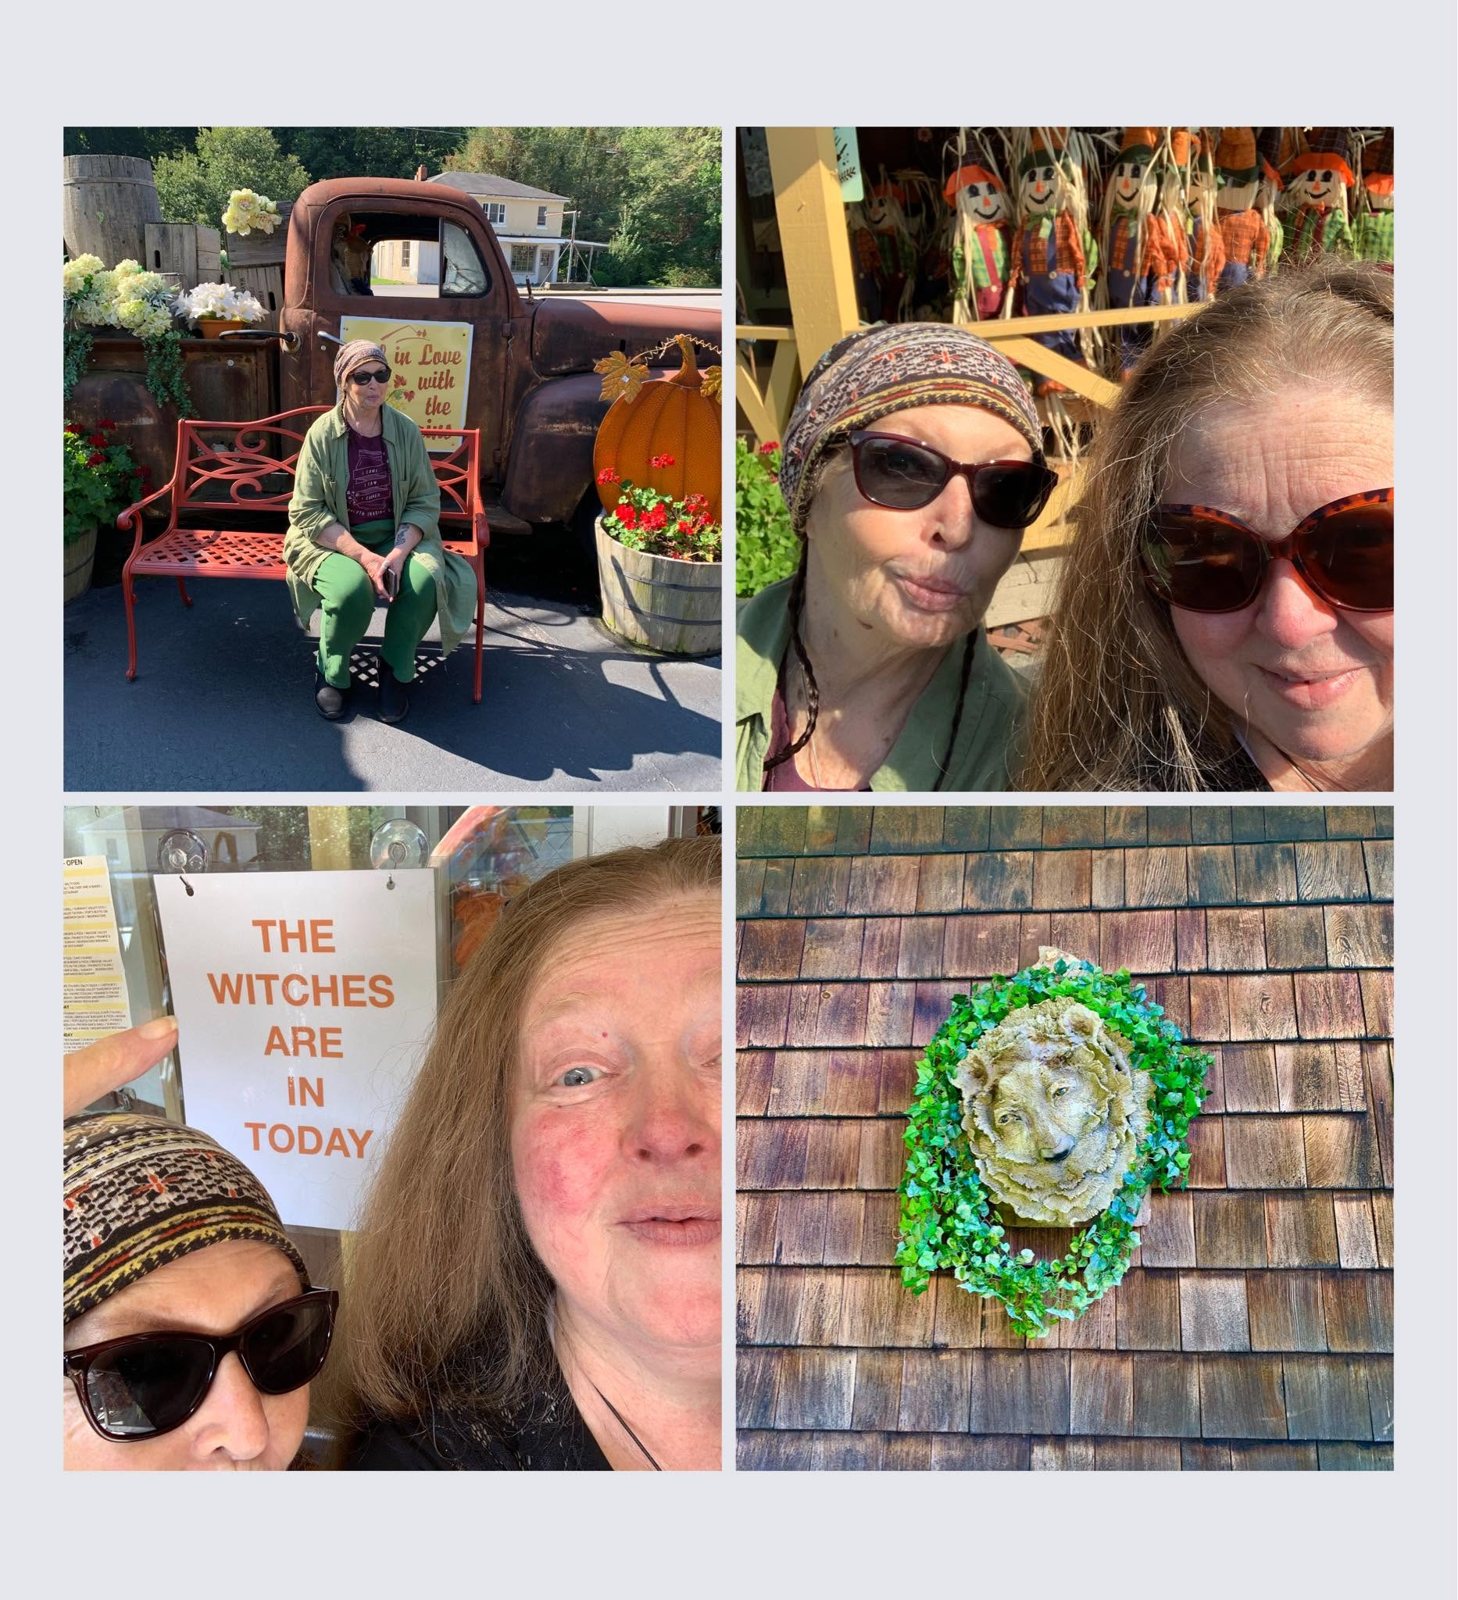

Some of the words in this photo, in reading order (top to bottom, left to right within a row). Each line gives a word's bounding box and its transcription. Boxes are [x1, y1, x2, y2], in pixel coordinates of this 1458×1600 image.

[394, 346, 412, 366] in
[418, 344, 463, 366] Love
[417, 369, 456, 390] with
[425, 395, 452, 416] the
[251, 919, 336, 953] THE
[207, 973, 395, 1009] WITCHES
[264, 1025, 343, 1058] ARE
[287, 1076, 324, 1107] IN
[244, 1122, 373, 1159] TODAY
